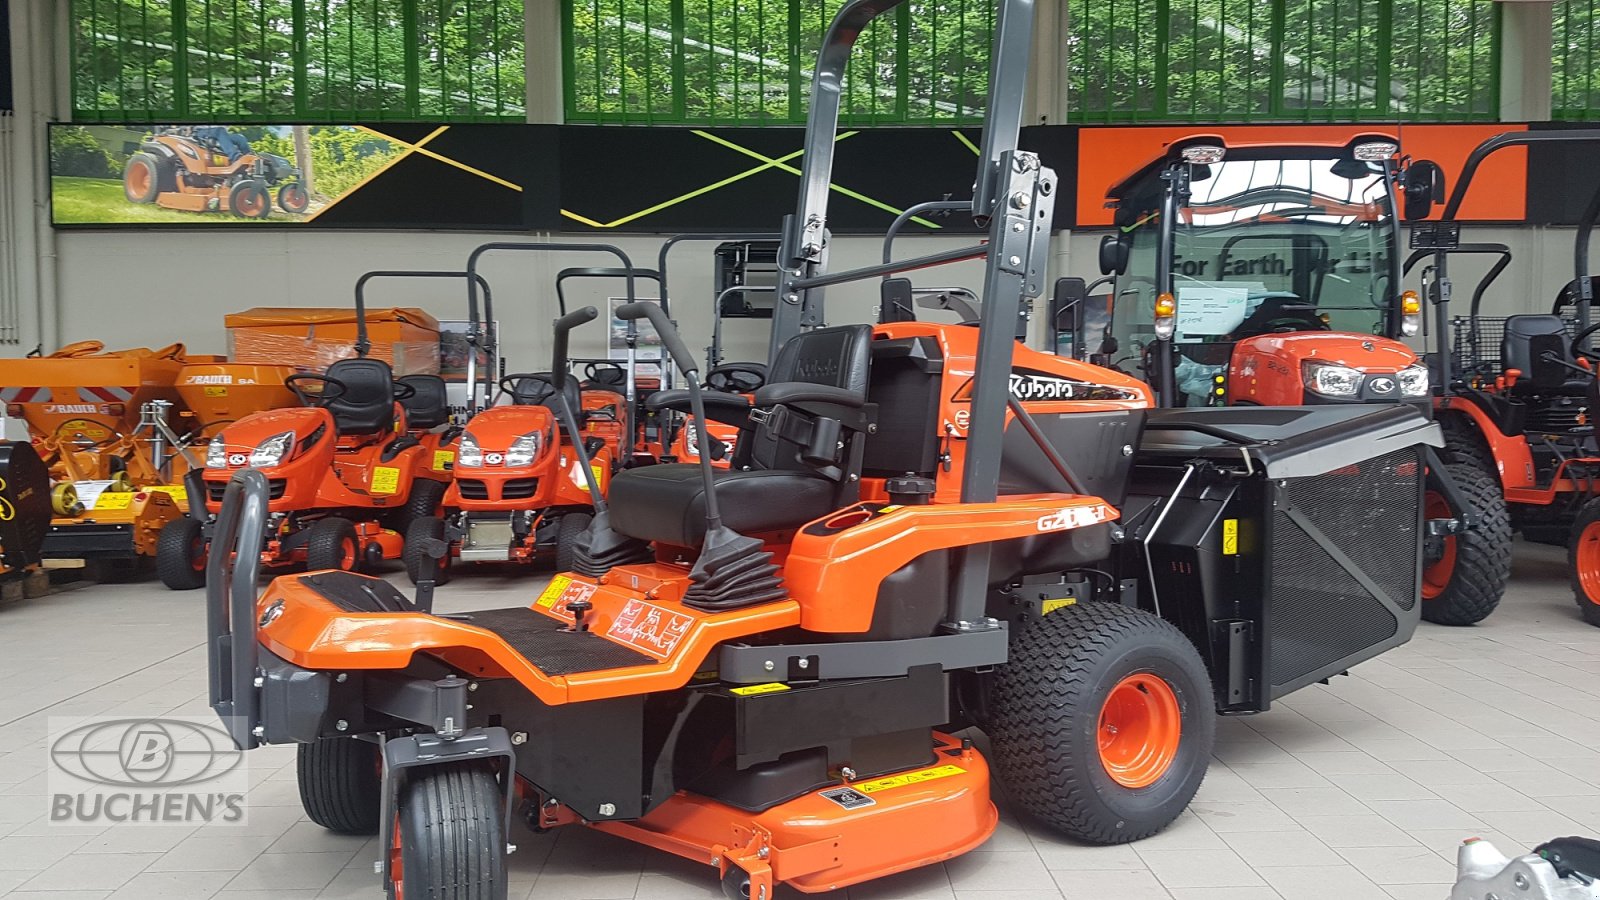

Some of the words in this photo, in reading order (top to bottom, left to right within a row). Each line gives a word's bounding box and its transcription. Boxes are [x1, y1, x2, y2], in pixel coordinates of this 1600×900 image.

[194, 375, 232, 385] RAUCH
[1009, 378, 1073, 398] Kubota
[57, 404, 97, 414] RAUCH
